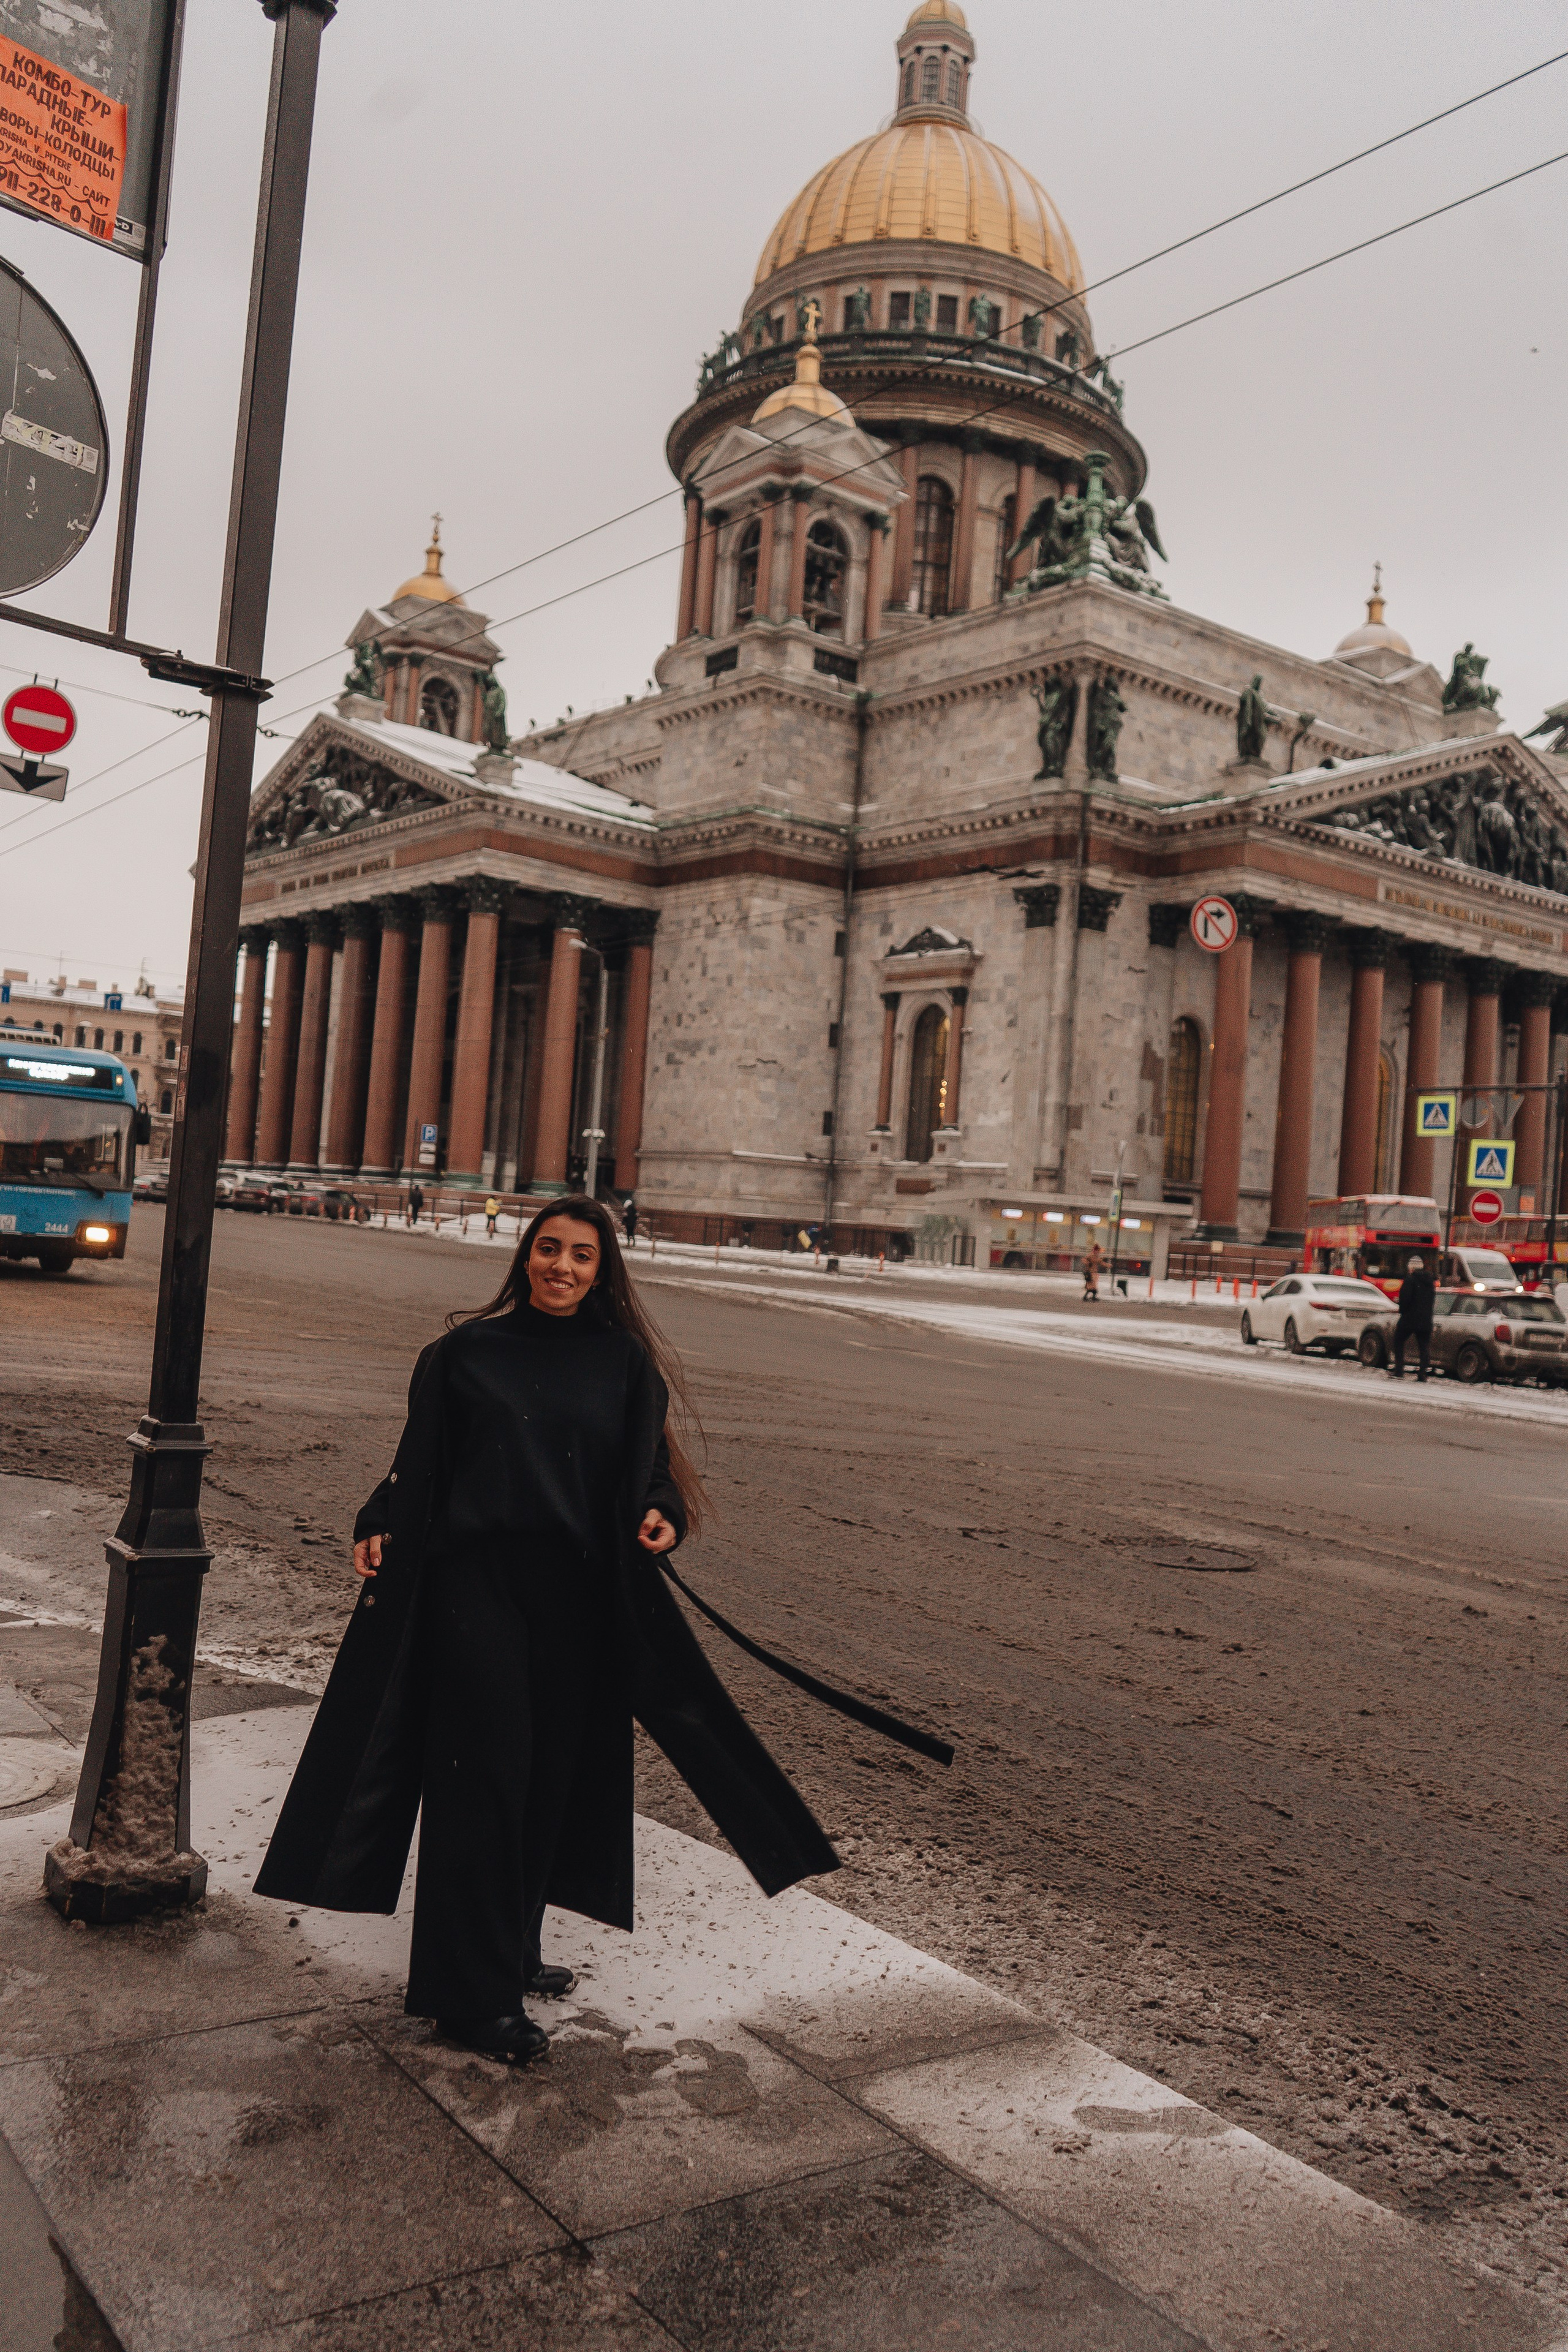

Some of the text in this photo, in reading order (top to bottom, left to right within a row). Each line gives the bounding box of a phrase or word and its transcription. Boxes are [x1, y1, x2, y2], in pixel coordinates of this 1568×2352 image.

[12, 51, 111, 118] КОМБО-ТУР
[50, 113, 120, 162] КРЫШИ-
[82, 185, 111, 207] САЙТ
[45, 1222, 69, 1233] 2444
